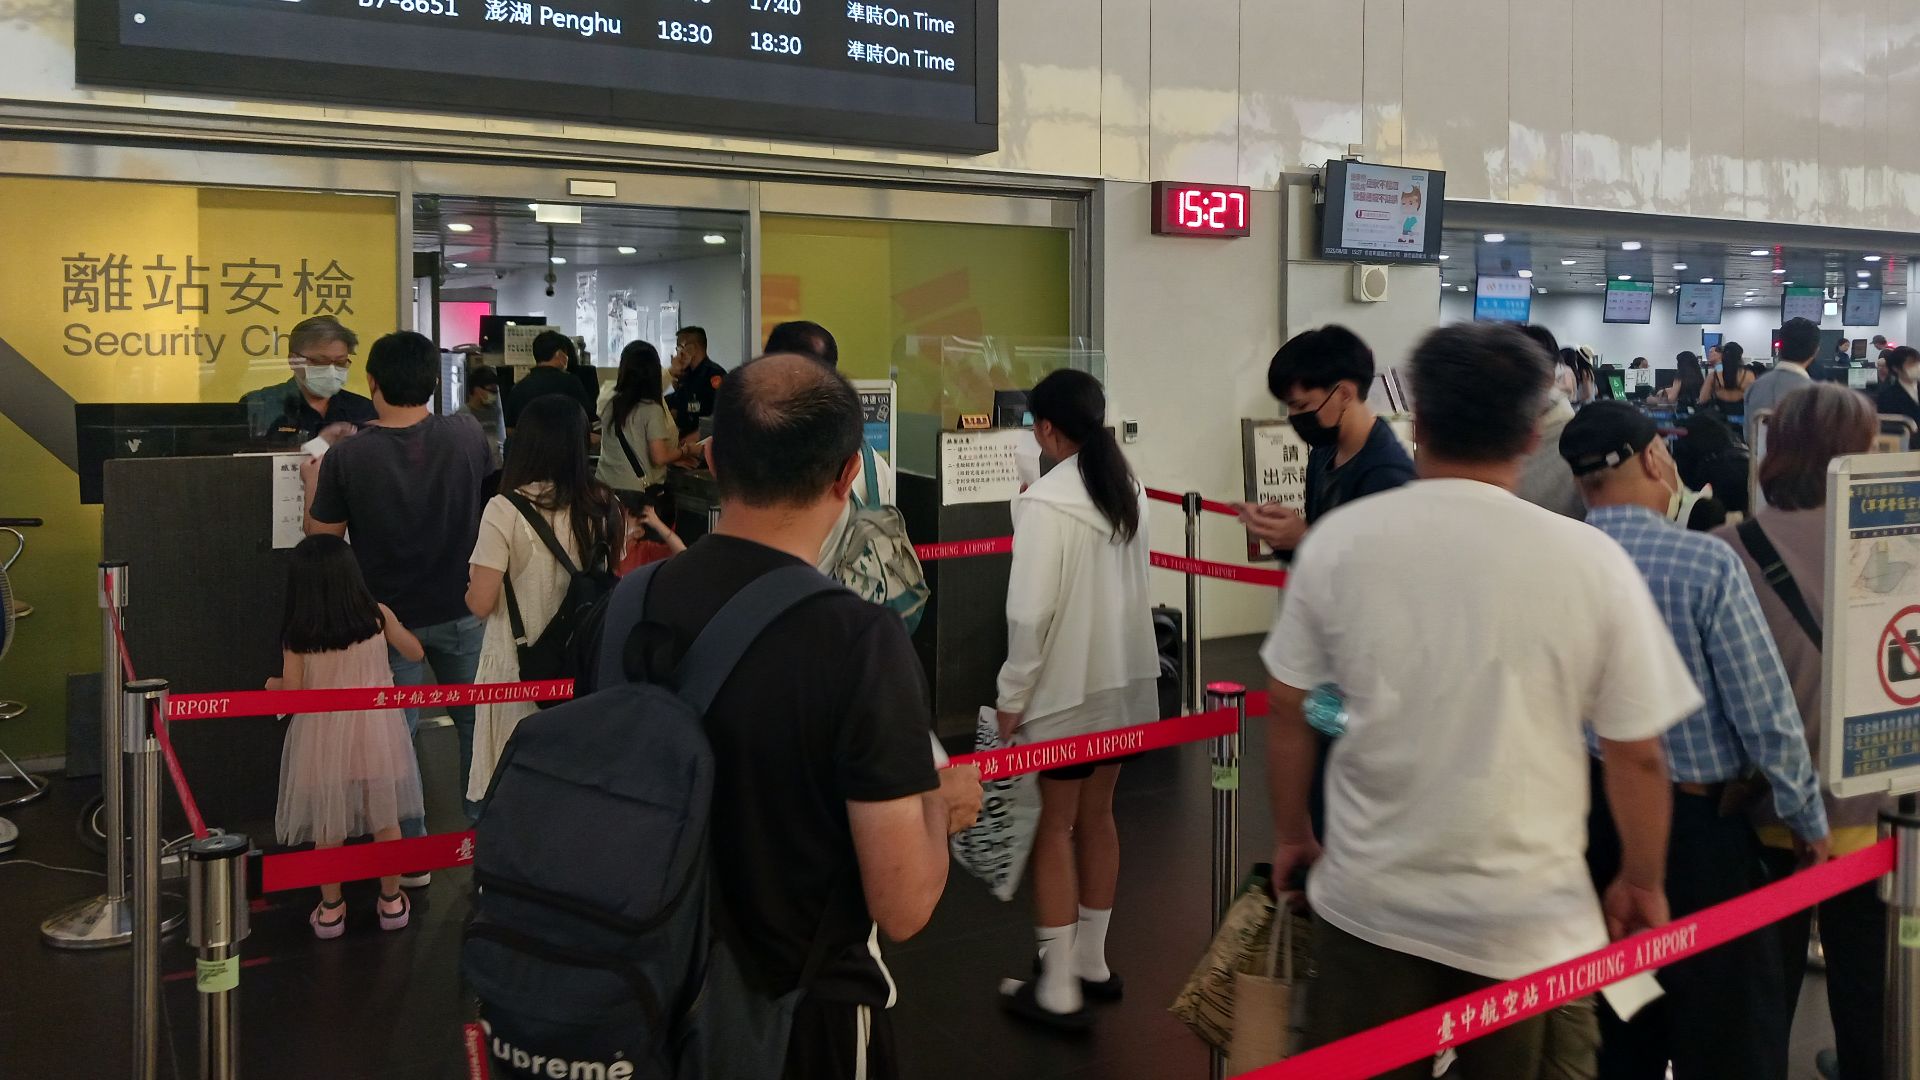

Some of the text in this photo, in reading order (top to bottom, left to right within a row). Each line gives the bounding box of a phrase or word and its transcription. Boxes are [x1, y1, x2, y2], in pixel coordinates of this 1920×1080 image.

[750, 0, 801, 16] 17:40
[913, 11, 955, 34] Time
[484, 0, 532, 25] 澎湖
[540, 6, 621, 37] Penghu
[657, 20, 713, 44] 18:30
[750, 31, 802, 55] 18:30
[913, 49, 955, 72] Time
[1178, 190, 1244, 229] 15:27
[61, 251, 355, 316] 離站安檢
[62, 322, 227, 364] Security
[1283, 444, 1299, 463] 請
[1259, 491, 1295, 504] Please
[920, 541, 996, 559] TAICHUNG AIRPORT
[1206, 564, 1236, 579] AIRPORT
[167, 698, 230, 716] IRPORT
[373, 689, 461, 707] 臺中航空站
[467, 685, 540, 701] TAICHUNG
[1005, 742, 1077, 772] TAICHUNG
[1086, 730, 1145, 758] AIRPORT
[1437, 922, 1698, 1046] 臺中航空站 TAICHUNG AIRPORT
